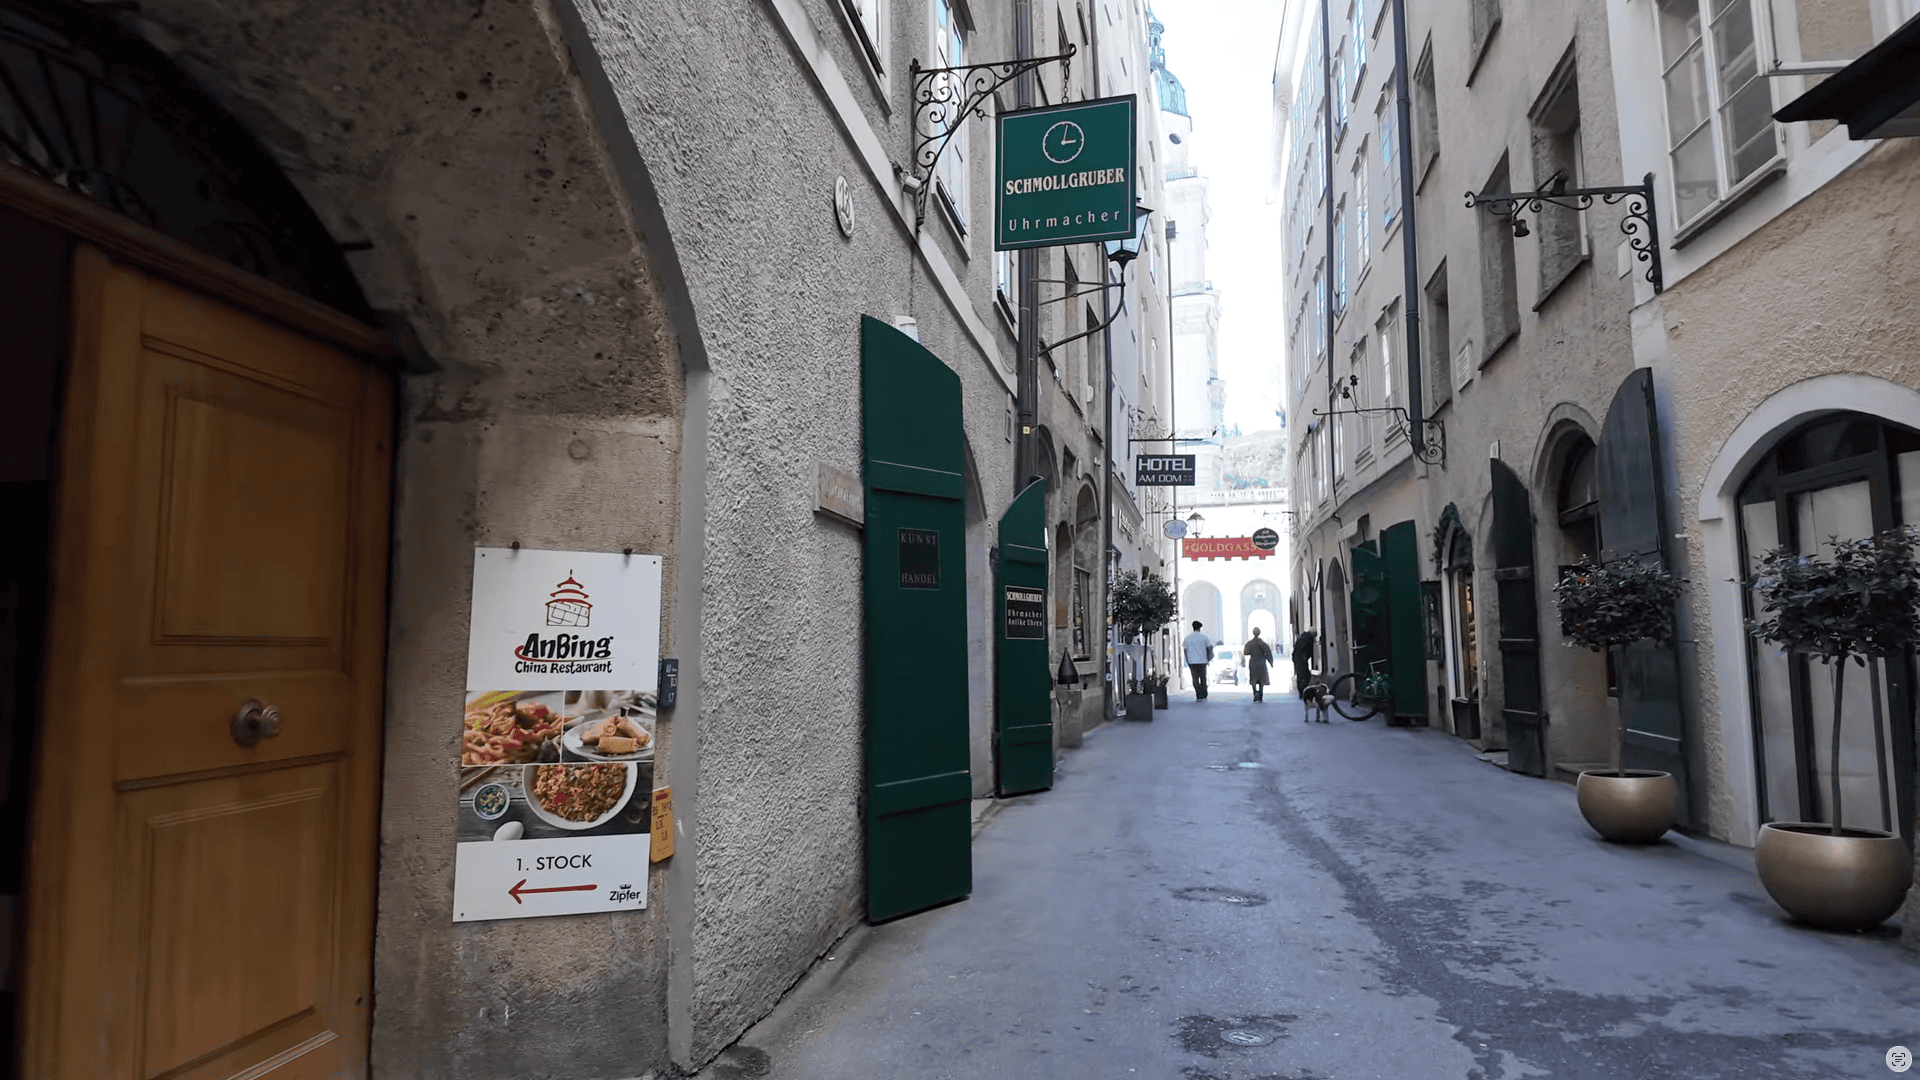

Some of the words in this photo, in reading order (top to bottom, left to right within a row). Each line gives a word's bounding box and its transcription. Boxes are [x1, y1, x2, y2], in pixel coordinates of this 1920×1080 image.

[1006, 168, 1125, 195] SCHMOLLGRUBER
[1009, 210, 1120, 231] Uhrmacher
[1138, 458, 1193, 471] HOTEL
[1138, 474, 1155, 482] AM
[1158, 474, 1182, 482] DOM
[900, 533, 937, 547] KUNST
[1191, 542, 1259, 553] GOLDGASS
[901, 572, 938, 584] HANDEL
[1006, 591, 1042, 602] SCHMOLLGRUBER
[1007, 609, 1042, 618] Uhrmacher
[522, 633, 614, 658] AnBing
[515, 661, 547, 674] China
[550, 660, 612, 674] Restaurant
[516, 858, 530, 871] 1.
[536, 854, 592, 870] STOCK
[609, 890, 641, 903] Zipfer
